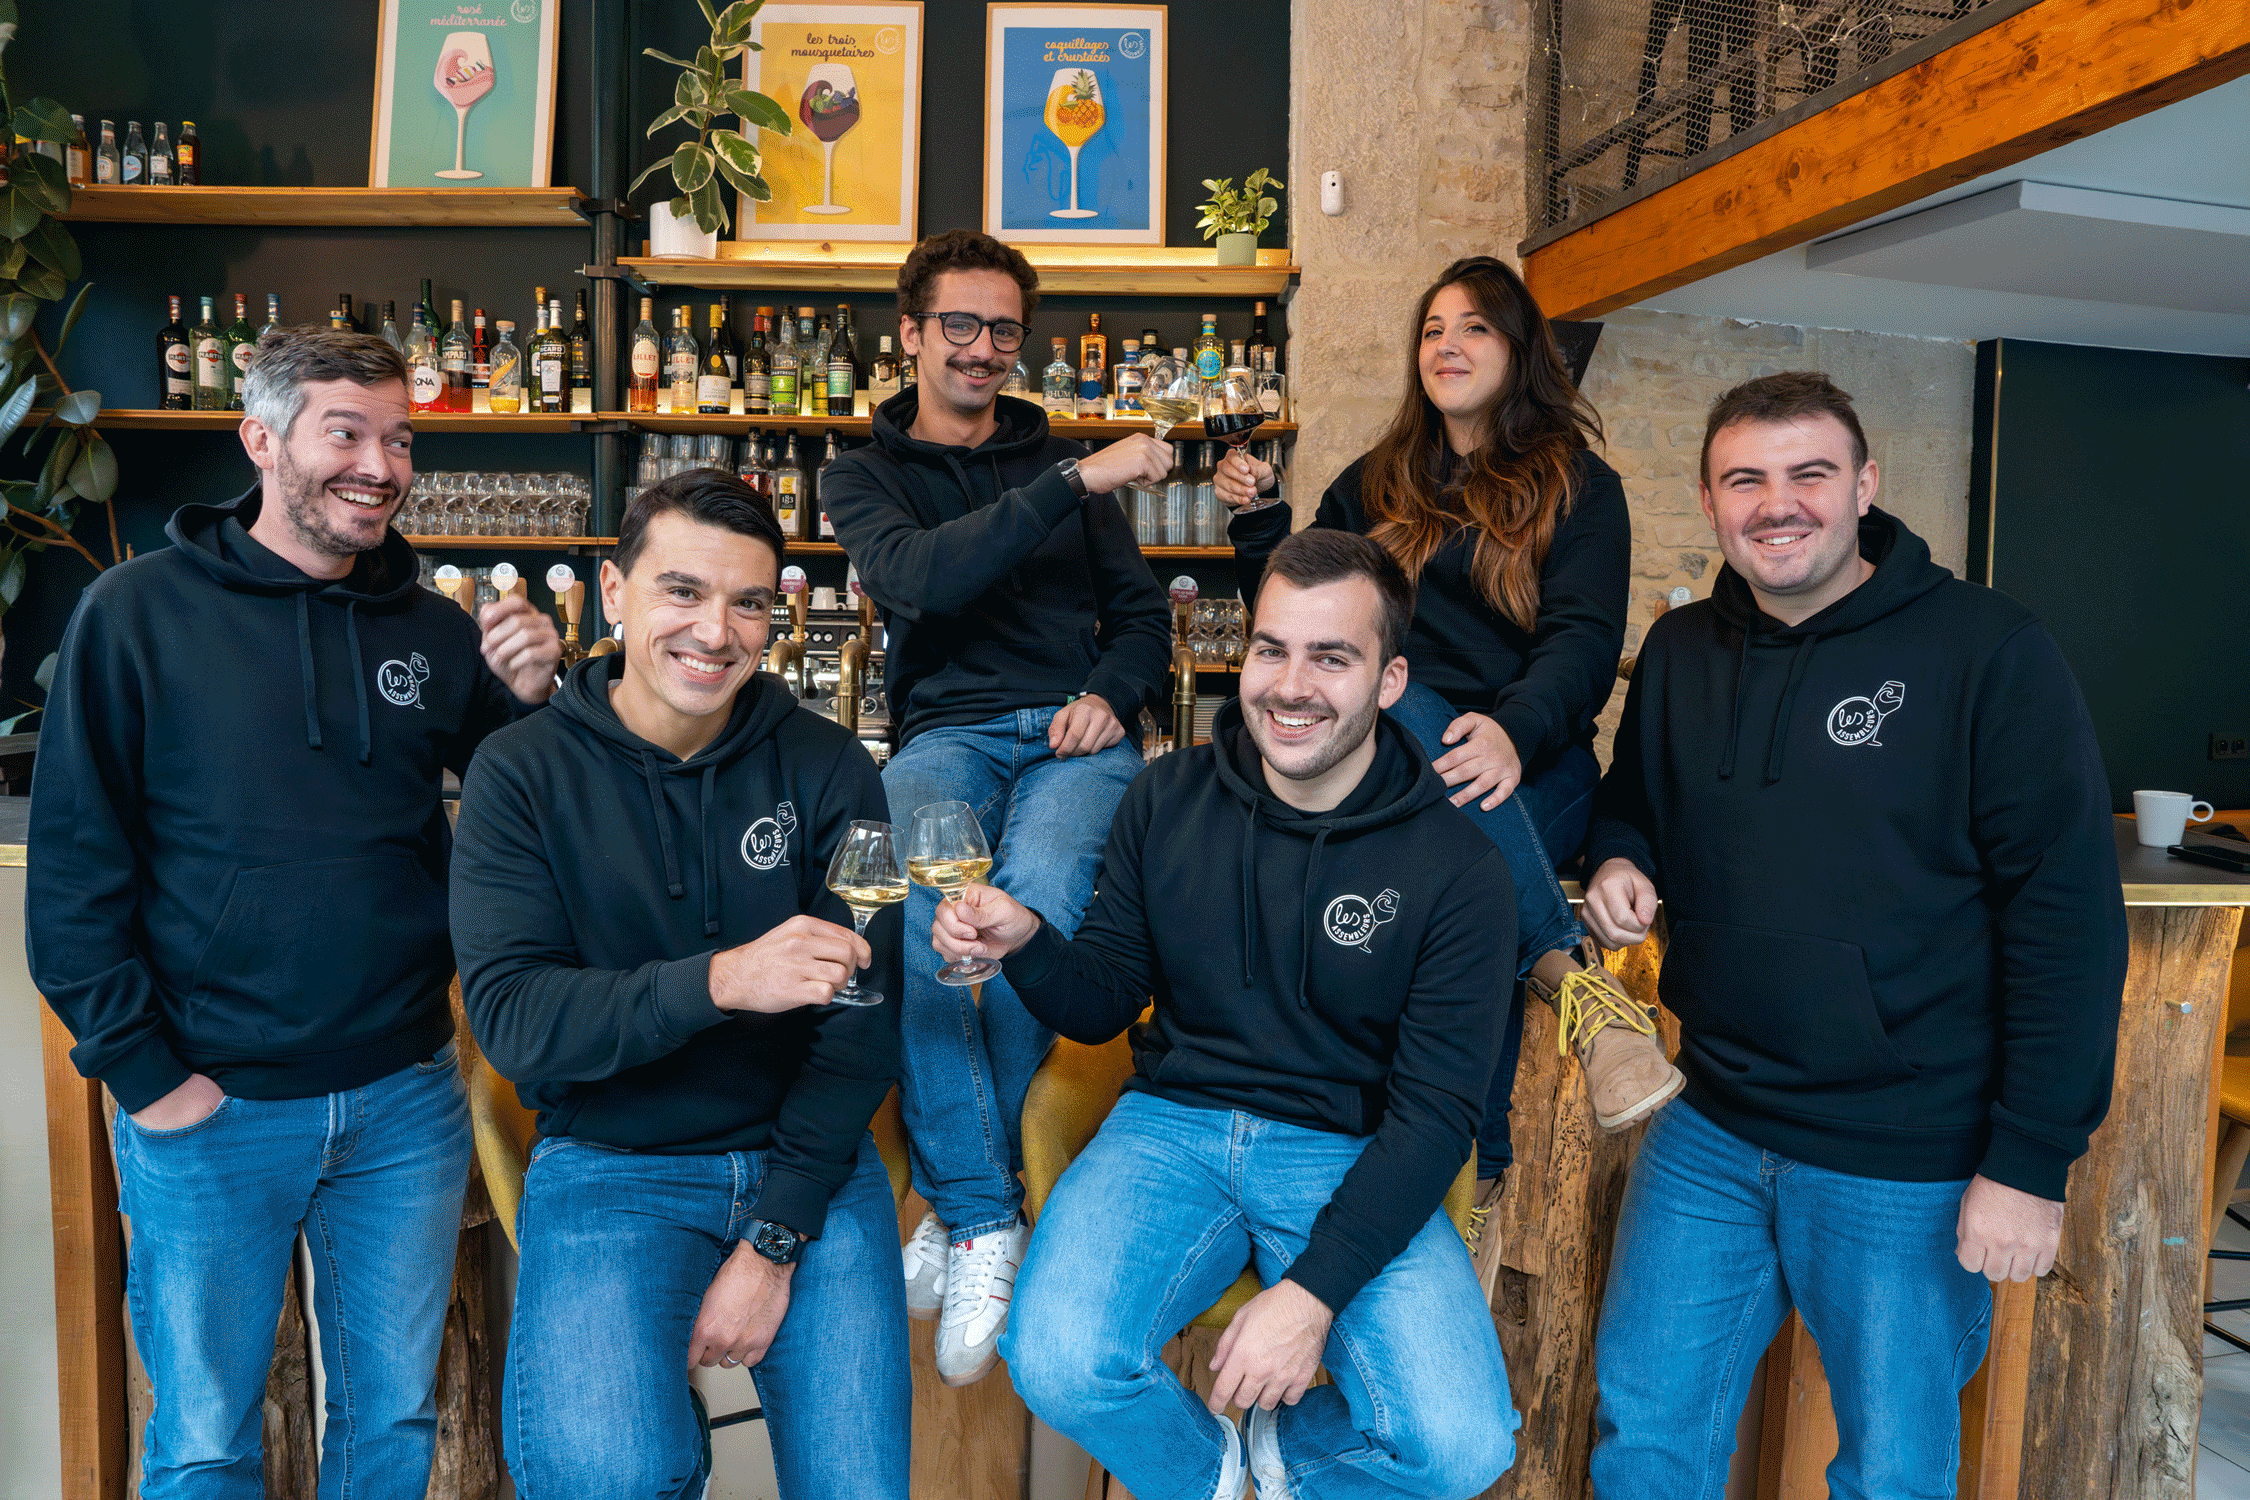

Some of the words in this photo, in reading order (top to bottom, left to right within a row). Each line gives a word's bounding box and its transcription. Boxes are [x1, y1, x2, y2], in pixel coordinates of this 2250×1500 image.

[456, 3, 483, 15] rosé
[430, 14, 507, 26] méditerranée
[806, 33, 823, 45] les
[828, 33, 856, 45] trois
[1045, 37, 1110, 54] coquillages
[791, 45, 875, 62] mousquetaires
[1043, 51, 1055, 62] et
[1057, 51, 1111, 62] crustacés
[633, 353, 656, 362] LILLET
[385, 668, 408, 687] les
[1835, 709, 1876, 741] ASSEMBLEURS
[1838, 708, 1864, 728] les
[750, 833, 772, 853] les
[1335, 903, 1361, 926] les
[1331, 913, 1371, 941] ASSEMBLEURS
